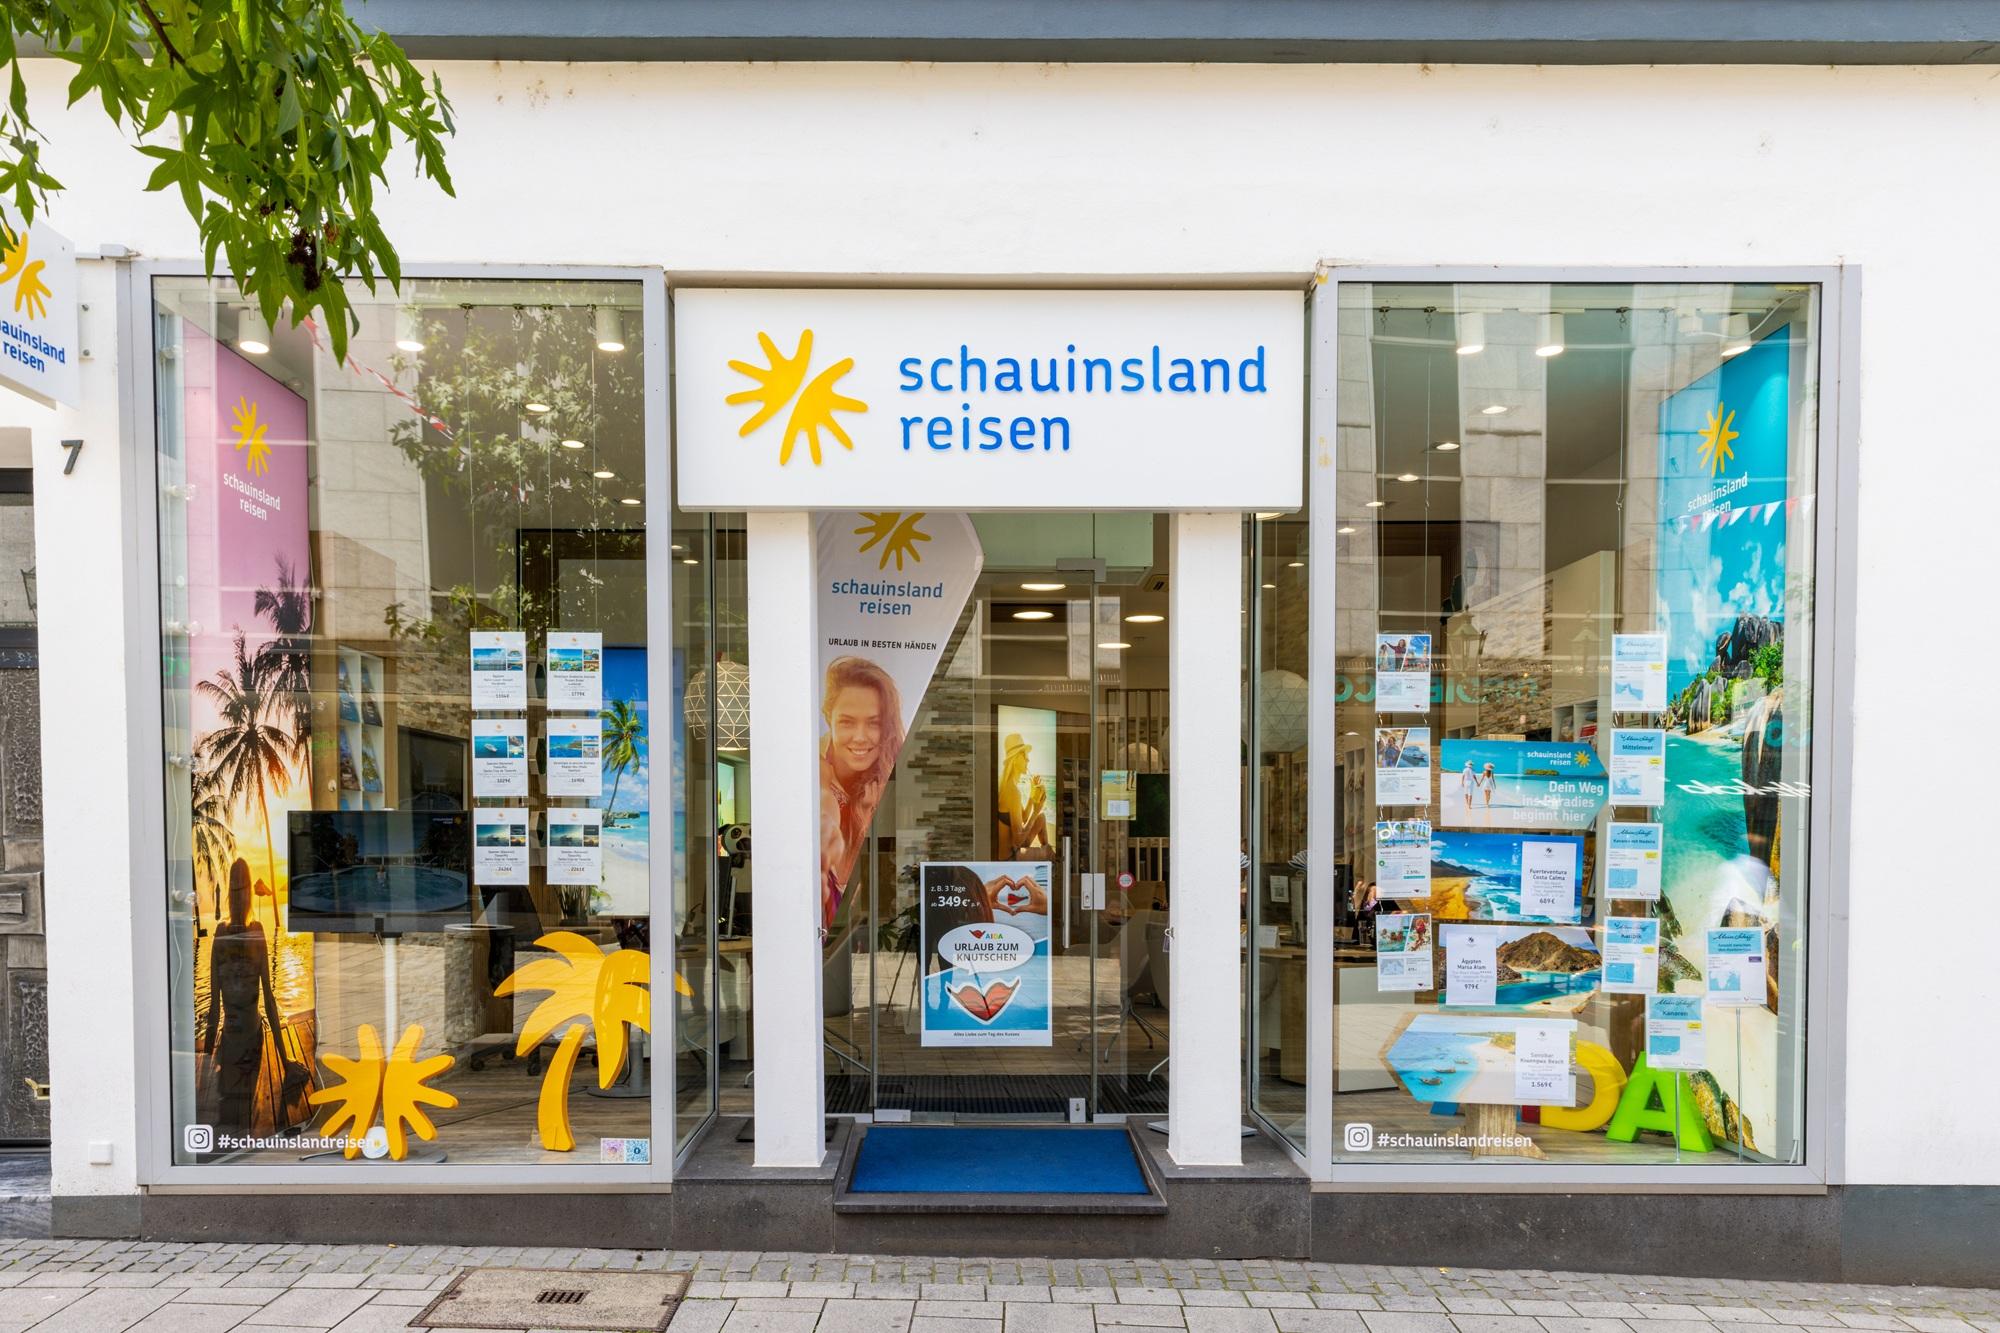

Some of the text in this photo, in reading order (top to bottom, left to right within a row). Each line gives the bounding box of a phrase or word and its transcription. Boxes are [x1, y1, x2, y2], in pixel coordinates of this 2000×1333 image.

[0, 320, 65, 364] auinsland
[3, 341, 45, 373] reisen
[899, 343, 1267, 393] schauinsland
[899, 402, 1071, 451] reisen
[60, 439, 84, 475] 7
[223, 472, 281, 512] schauinsland
[1687, 471, 1748, 512] schauinsland
[239, 498, 267, 521] reisen
[831, 578, 944, 598] schauinsland
[859, 598, 912, 616] reisen
[828, 637, 937, 650] URLAUB IN BESTEN HÄNDEN
[1527, 750, 1572, 759] schauinsland
[1548, 781, 1604, 796] Dein Weg
[1513, 808, 1585, 822] beginnt hier
[950, 885, 966, 894] Tage
[938, 895, 961, 907] 349
[954, 943, 1019, 951] URLAUB ZUM
[956, 953, 1017, 961] KNUTSCHEN
[1377, 1132, 1532, 1148] #schauinslandreisen
